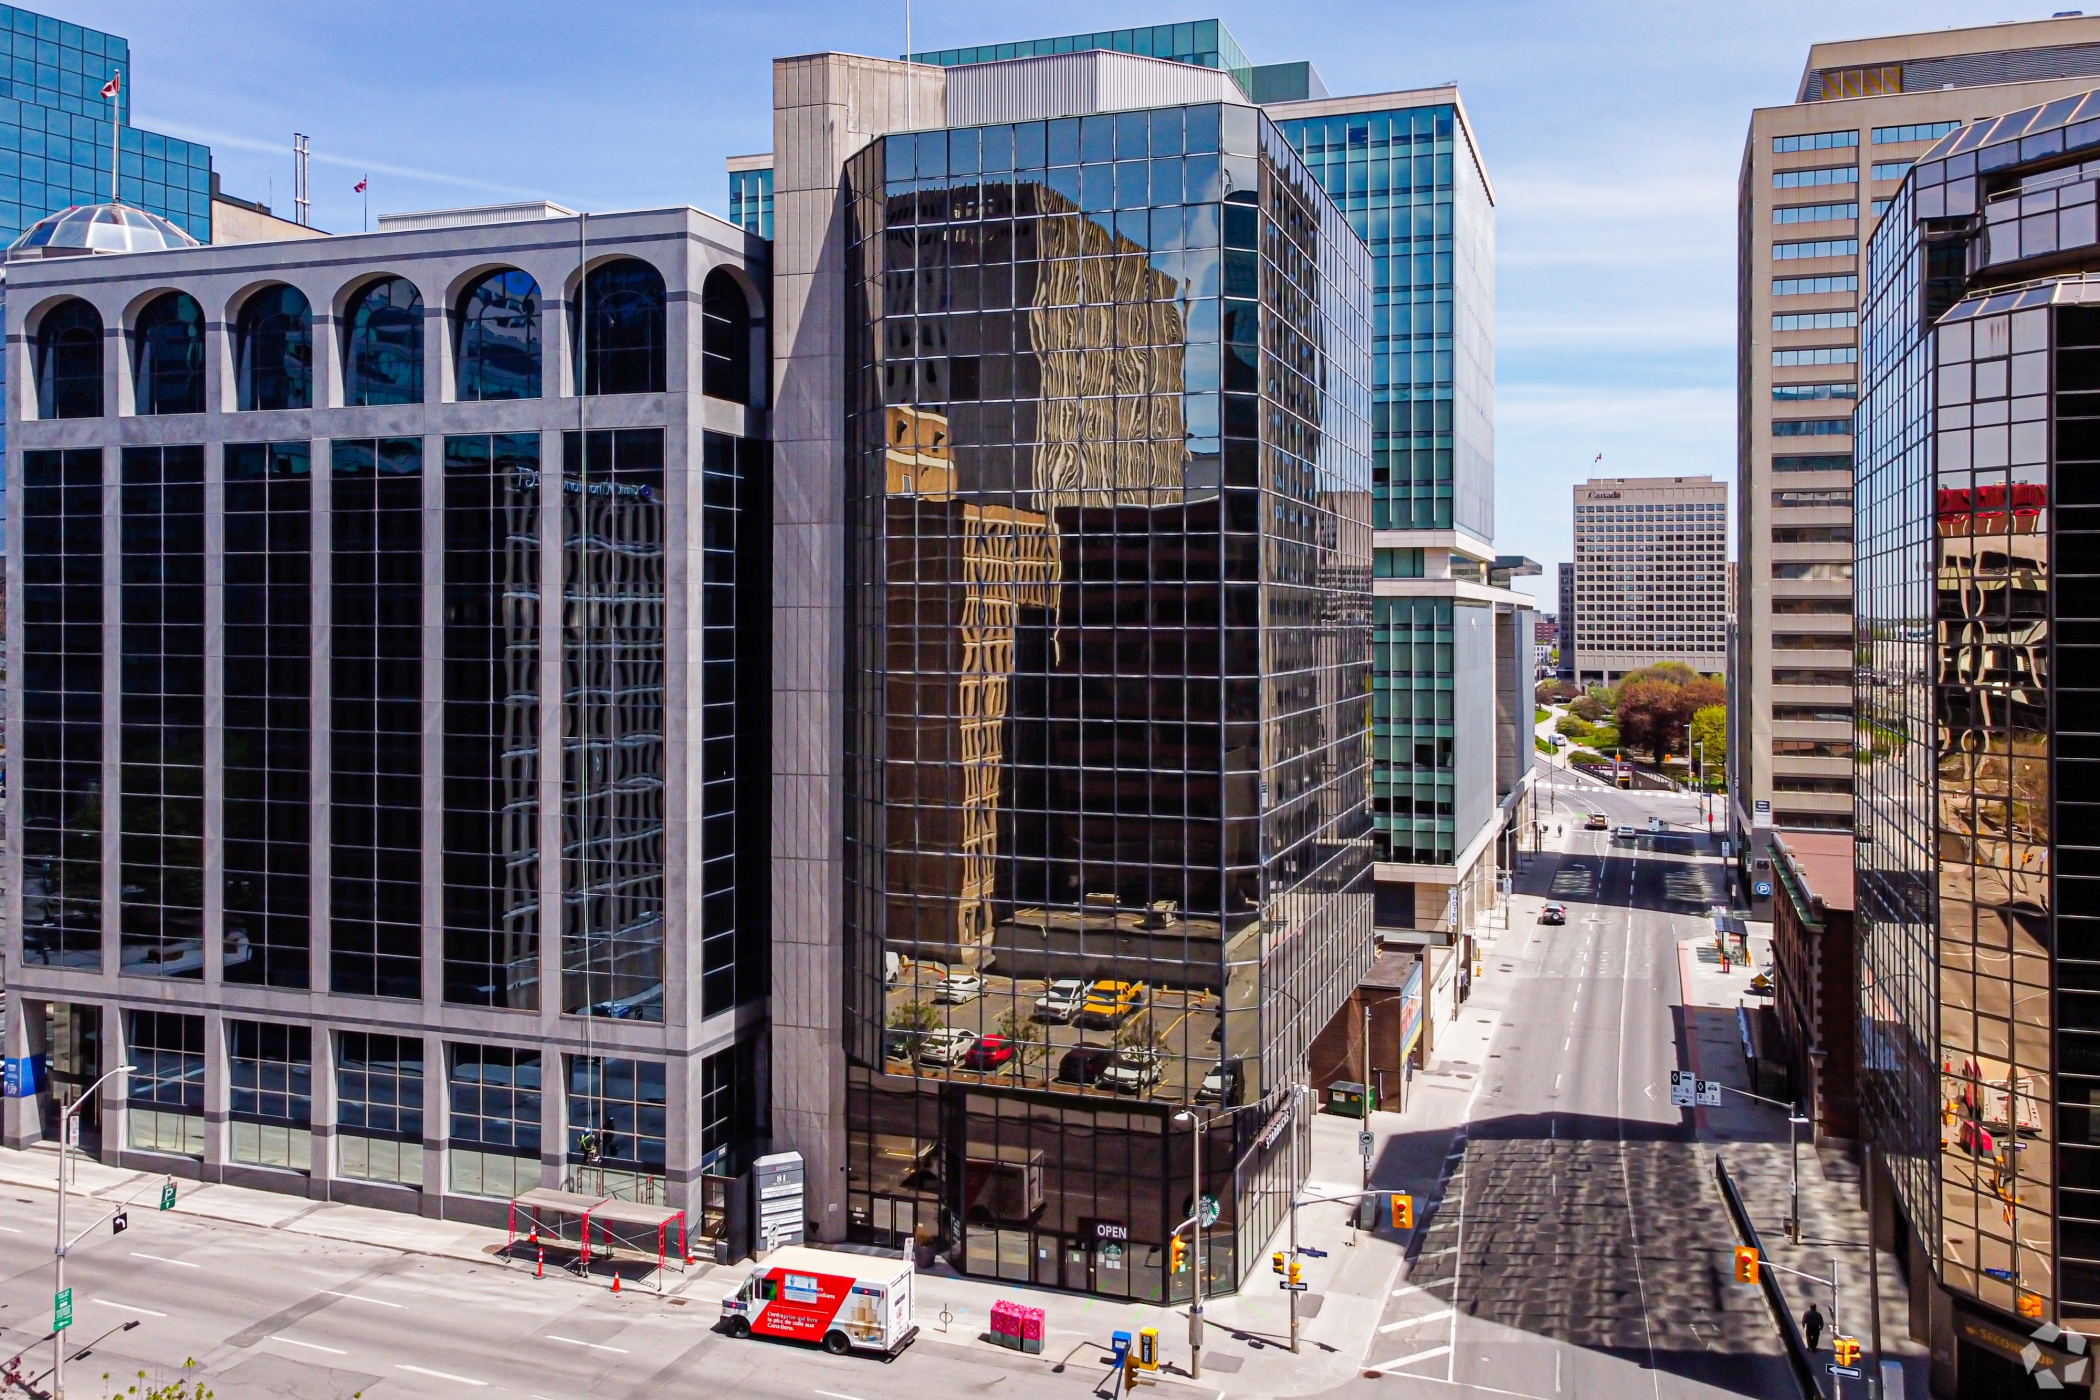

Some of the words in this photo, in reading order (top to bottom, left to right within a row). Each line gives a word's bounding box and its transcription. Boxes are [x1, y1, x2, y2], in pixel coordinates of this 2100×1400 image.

[1588, 490, 1621, 499] Canada
[1756, 860, 1770, 870] 66
[776, 1174, 787, 1183] 81
[164, 1188, 174, 1201] P
[1097, 1224, 1127, 1239] OPEN
[767, 1311, 797, 1321] L'entreprise
[767, 1323, 795, 1331] Canadiens.
